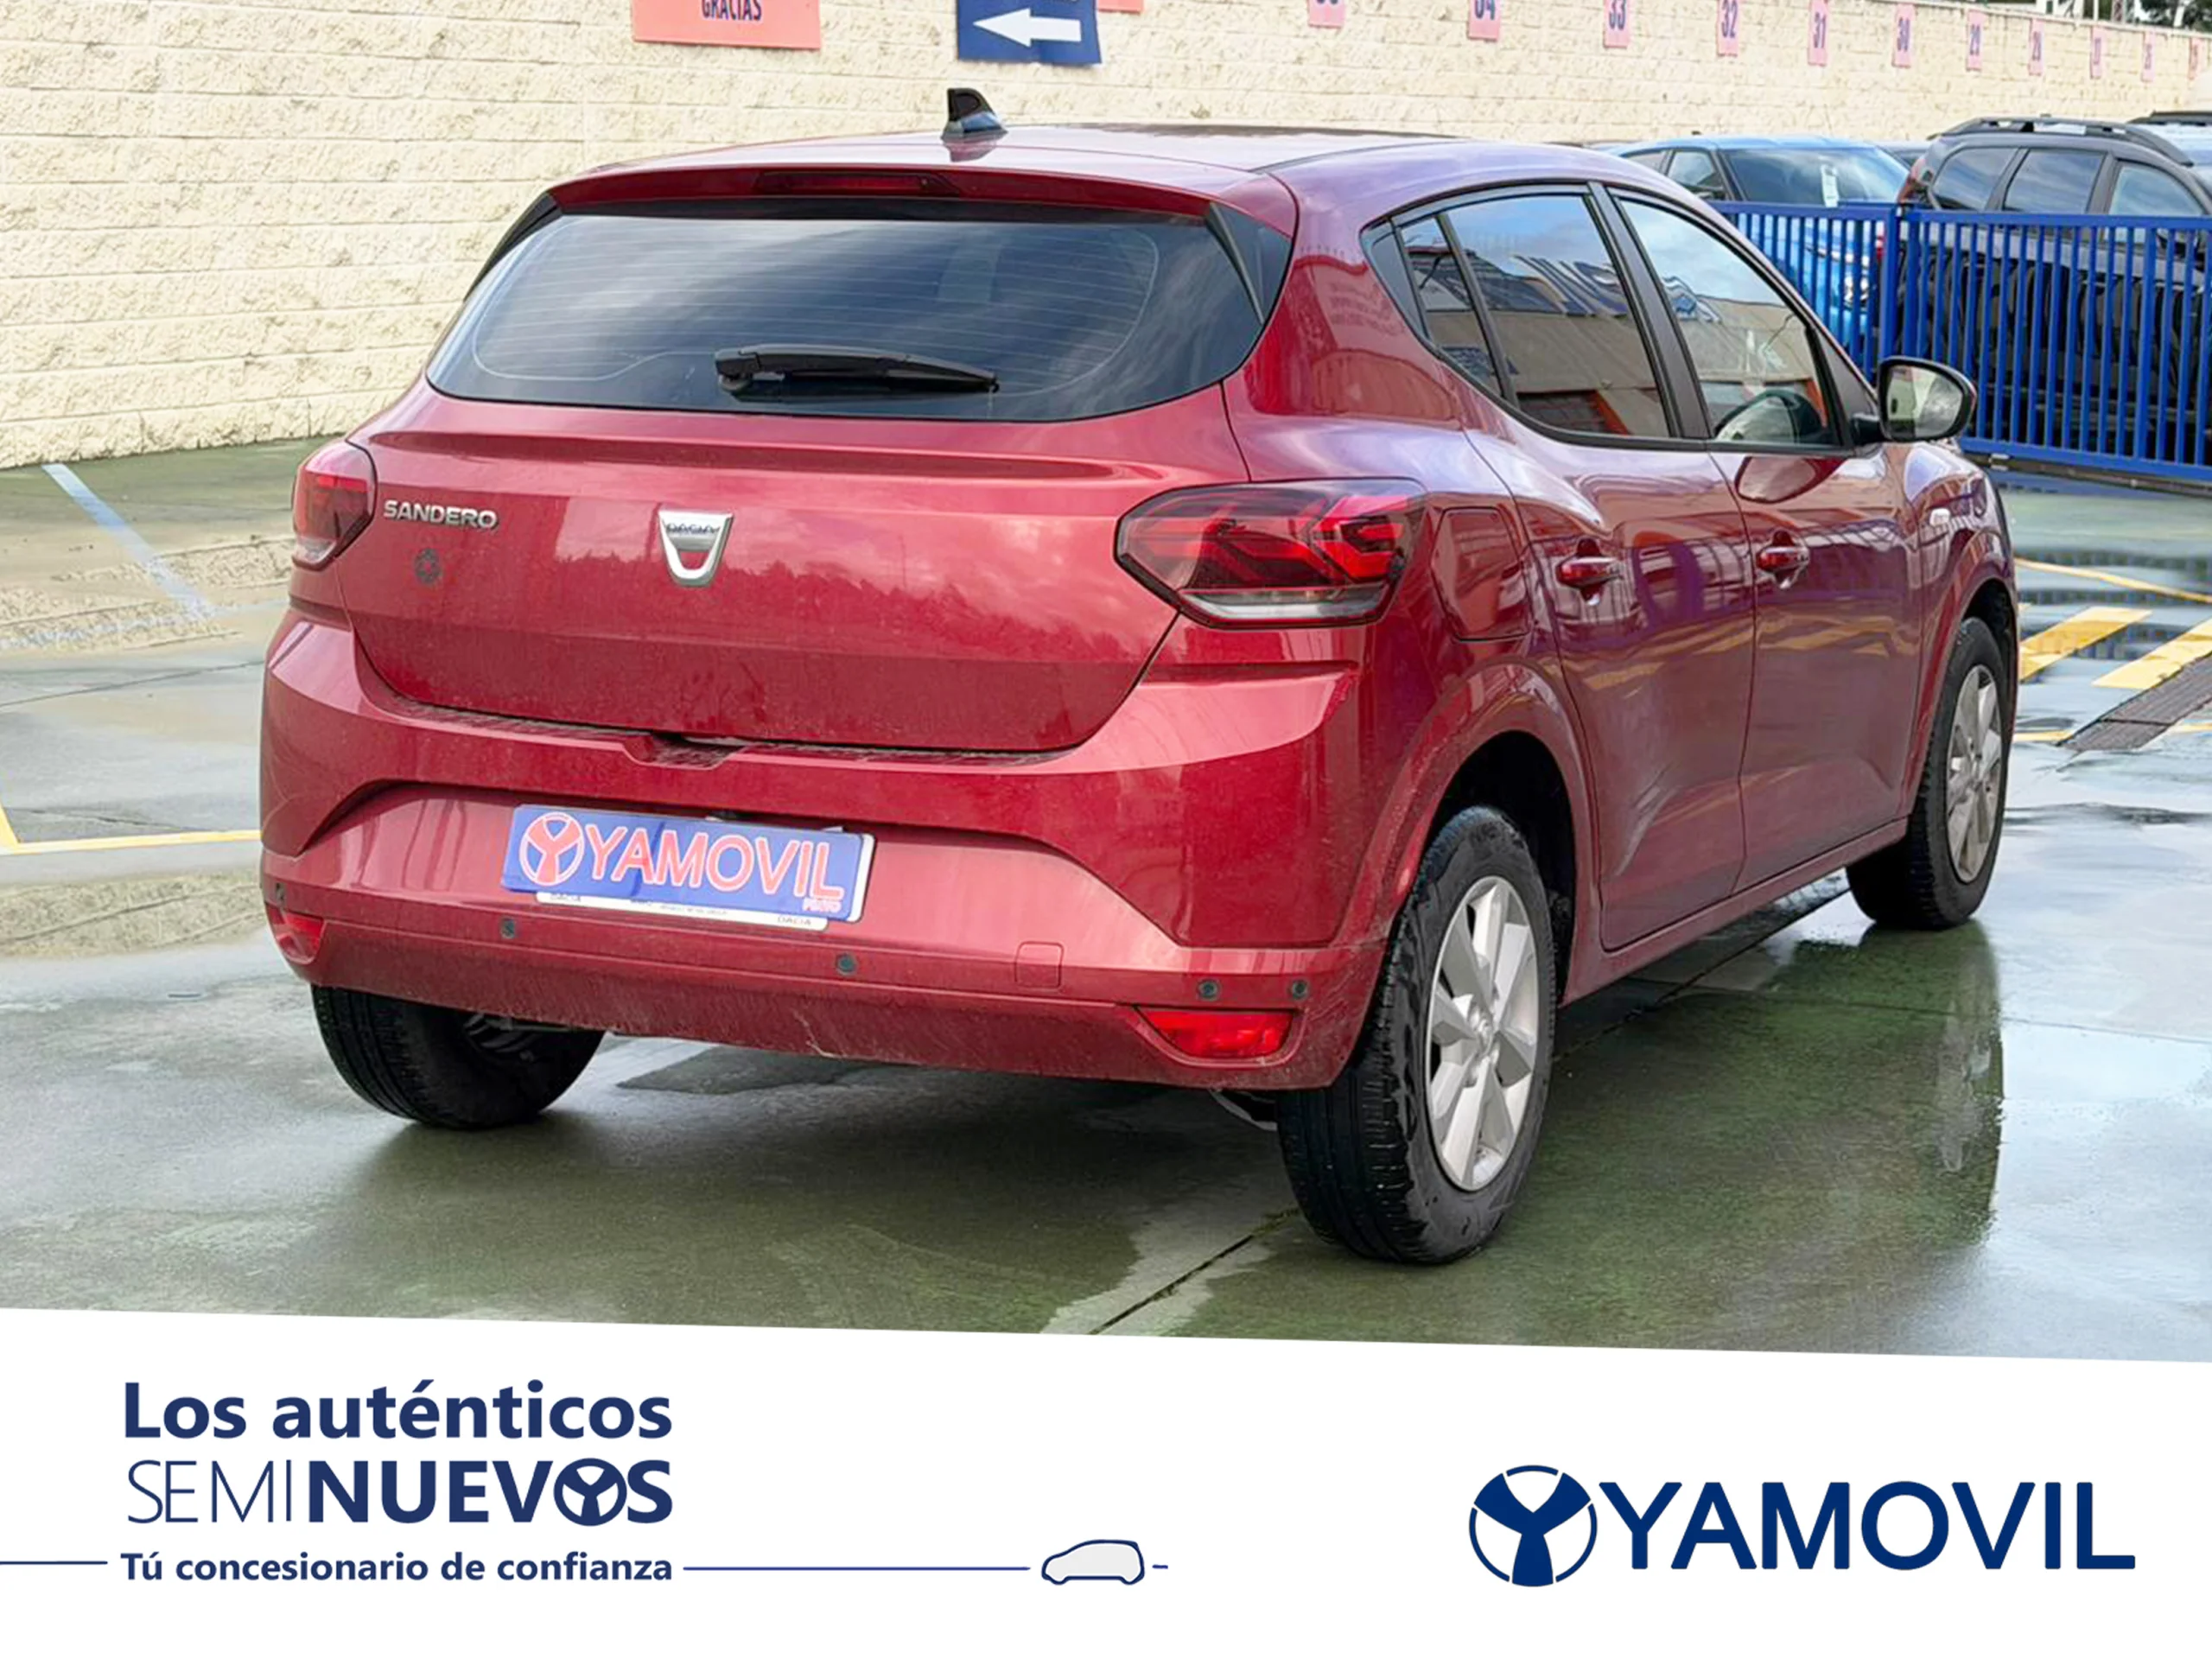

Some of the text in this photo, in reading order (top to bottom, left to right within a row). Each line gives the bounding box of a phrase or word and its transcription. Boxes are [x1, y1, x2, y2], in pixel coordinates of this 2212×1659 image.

[702, 0, 762, 21] GRACIAS
[1609, 0, 1626, 29] 33
[1721, 0, 1738, 38] 32
[1813, 12, 1827, 48] 31
[384, 499, 498, 530] SANDERO
[585, 823, 845, 899] YAMOVIL
